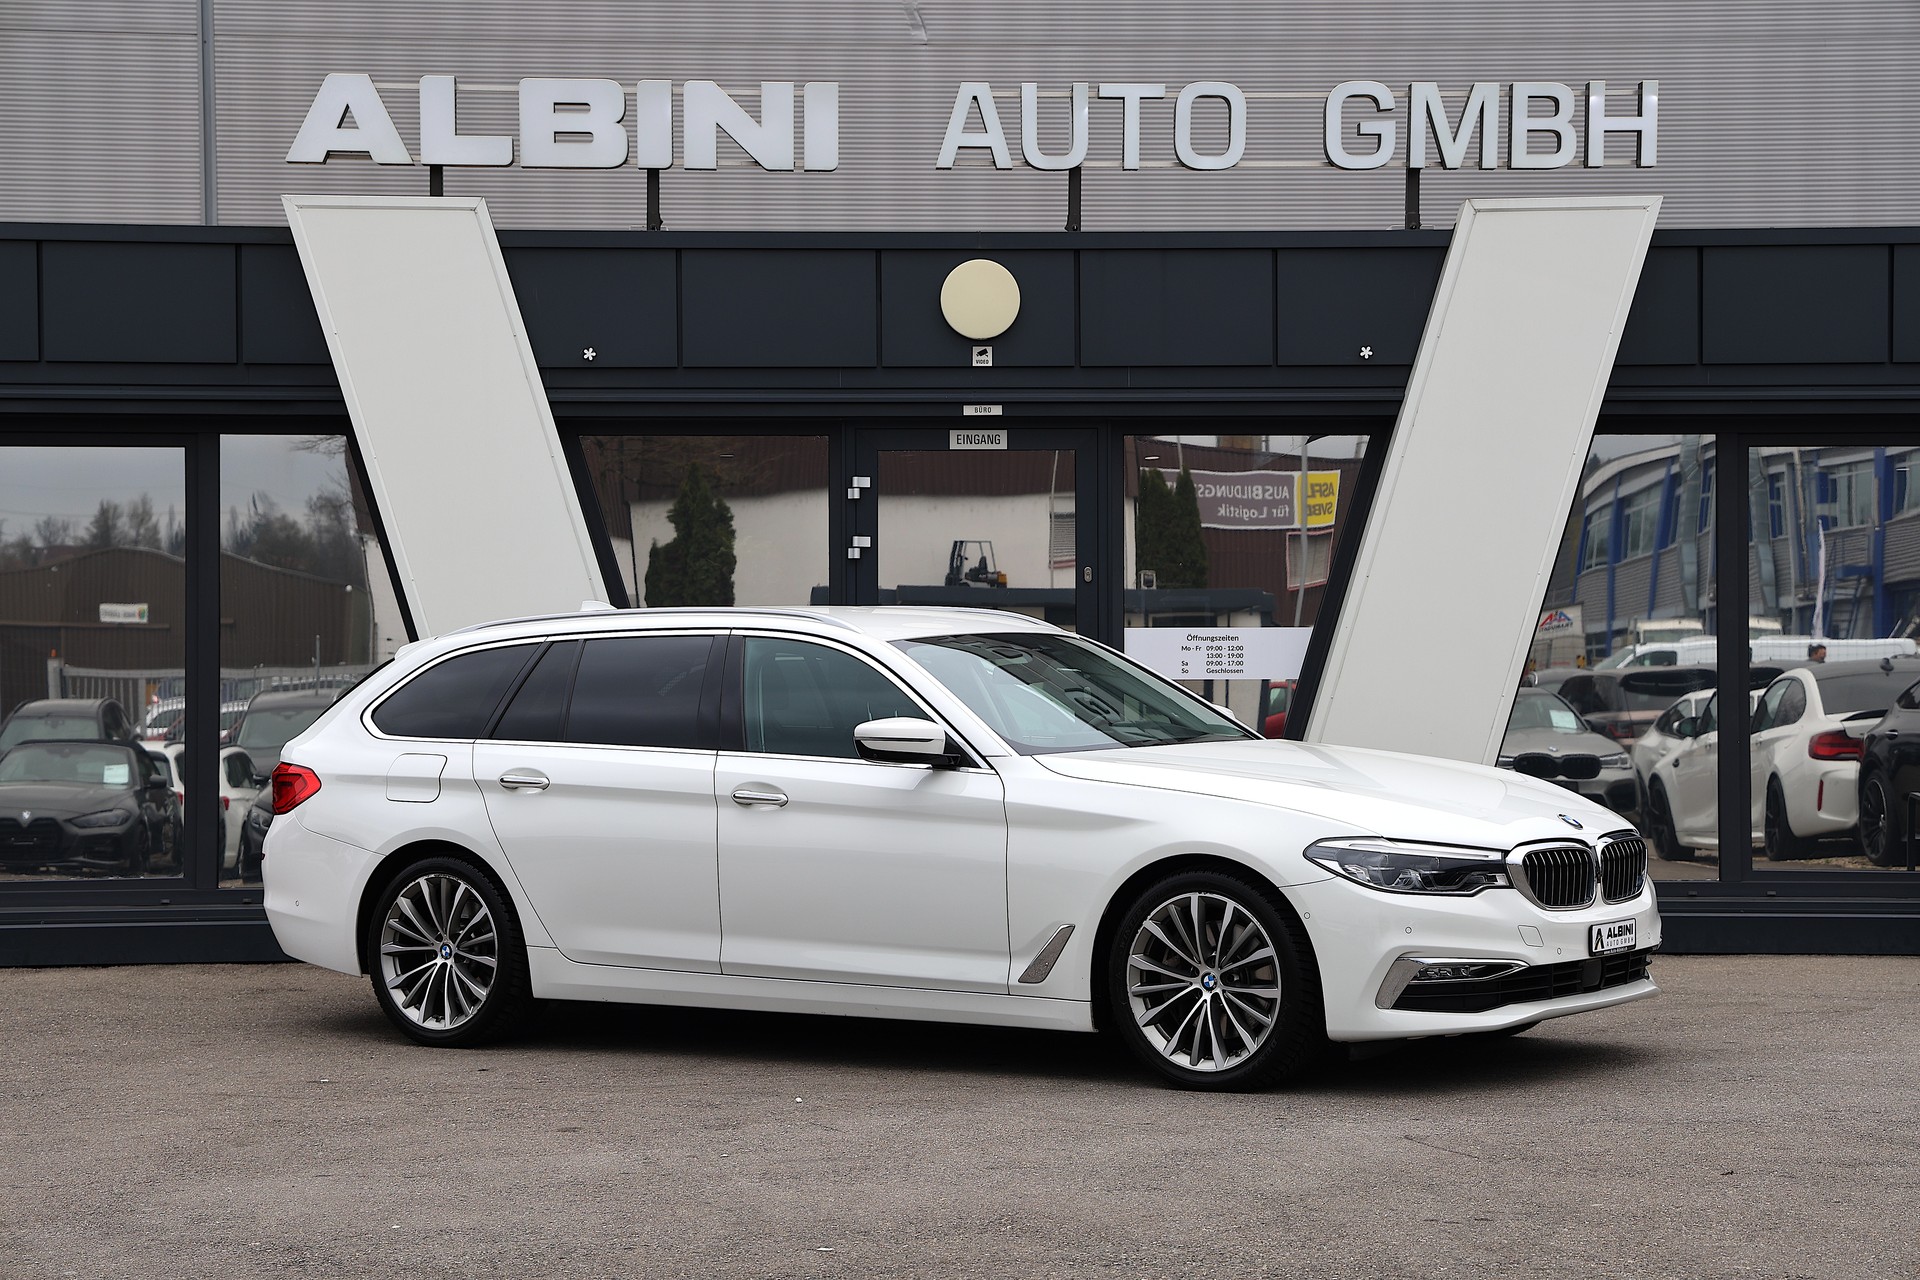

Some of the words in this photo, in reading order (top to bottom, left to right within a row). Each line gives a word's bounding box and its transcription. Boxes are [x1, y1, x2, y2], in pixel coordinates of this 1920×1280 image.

[285, 72, 839, 172] ALBINI
[935, 81, 1248, 171] AUTO
[1322, 79, 1660, 171] GMBH
[956, 434, 1001, 445] EINGANG
[1186, 634, 1239, 642] Öffnungszeiten
[1607, 923, 1633, 939] ALBINI
